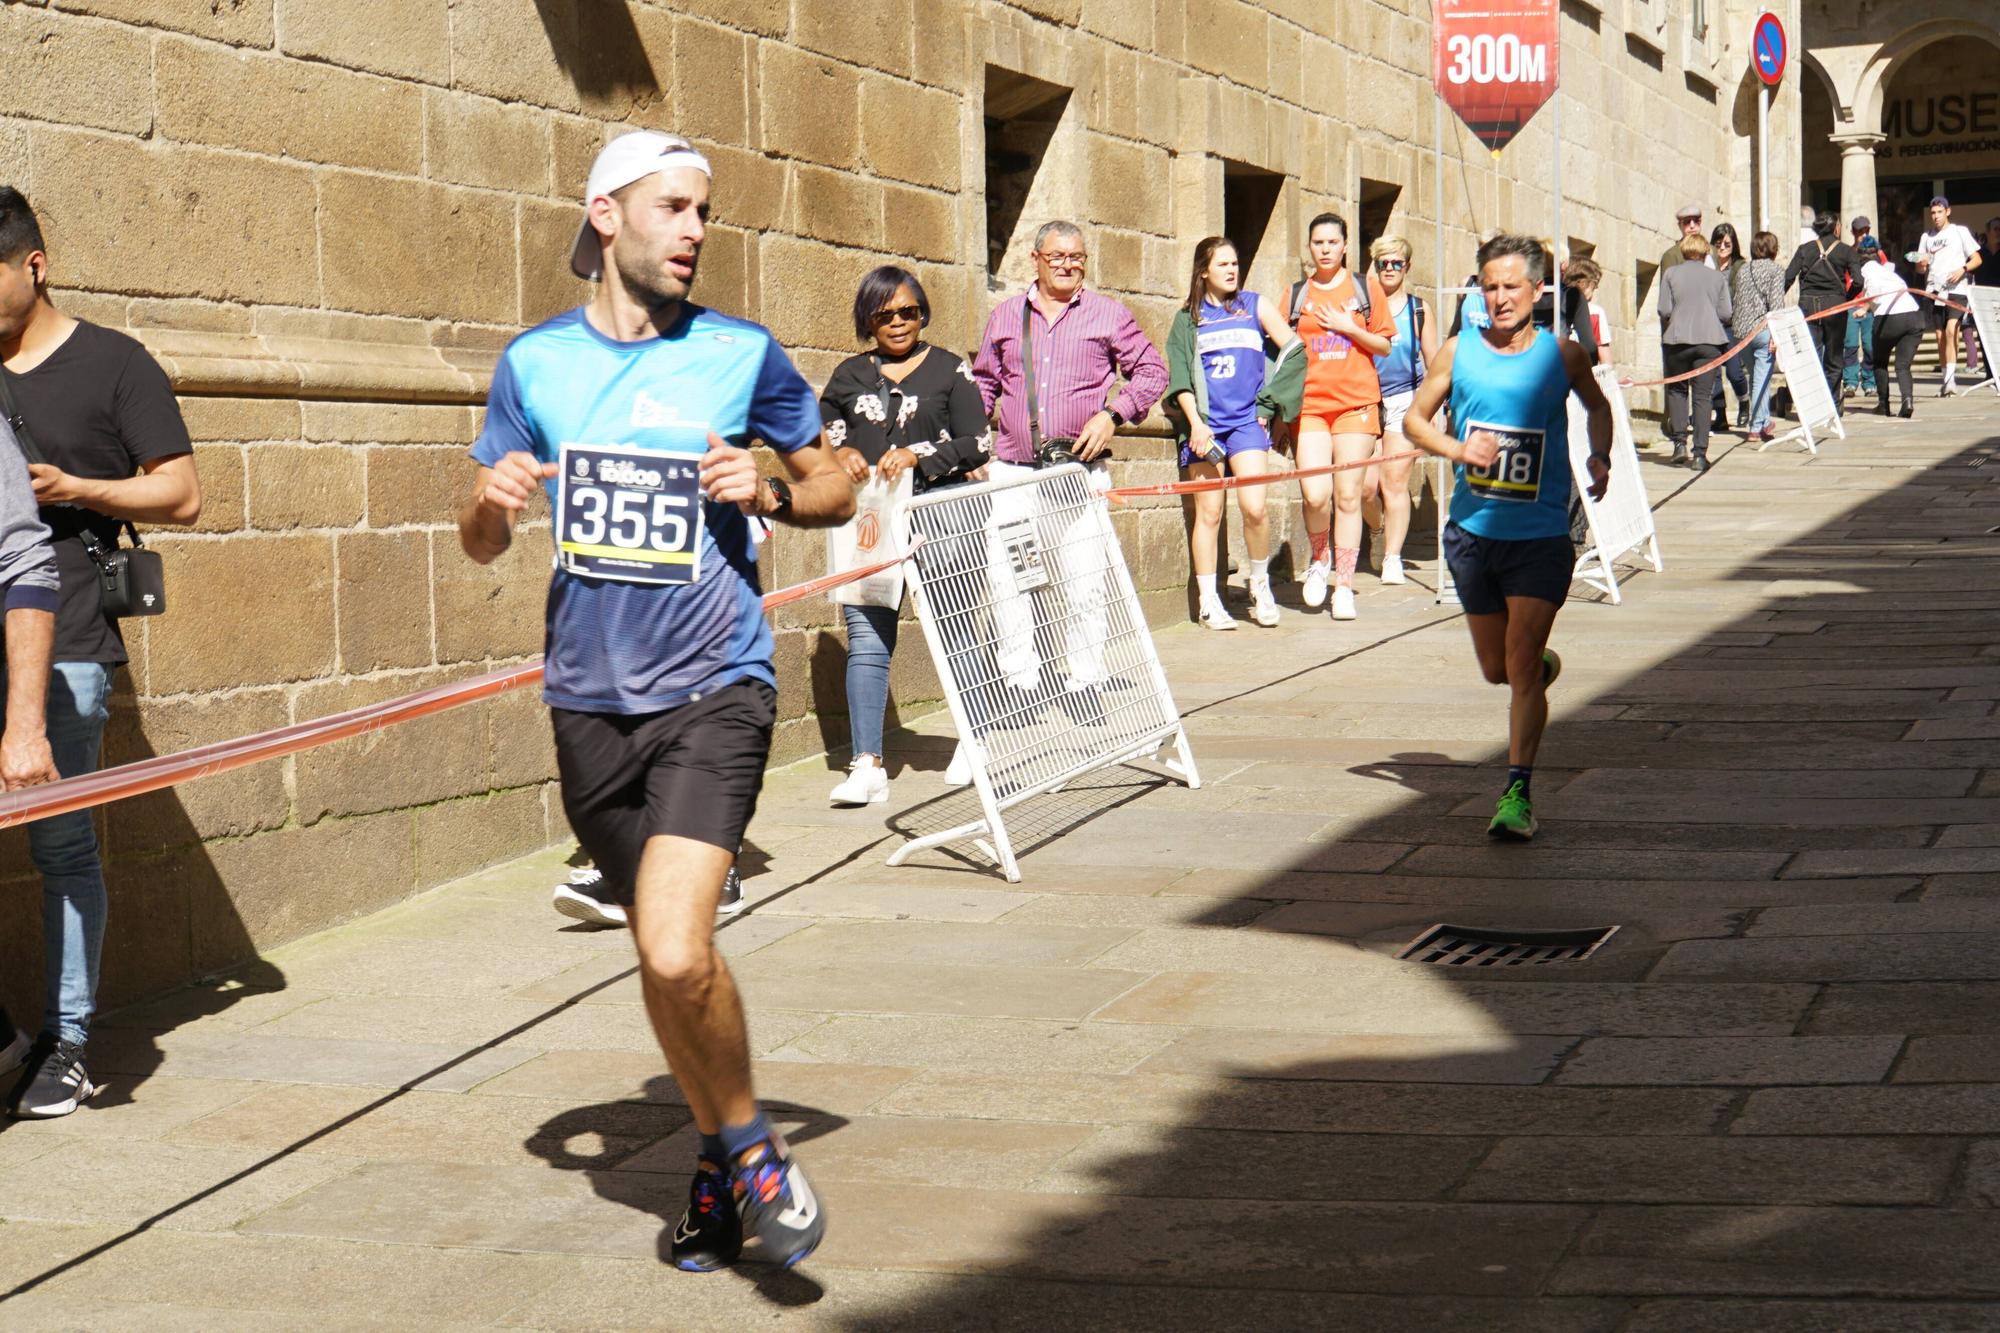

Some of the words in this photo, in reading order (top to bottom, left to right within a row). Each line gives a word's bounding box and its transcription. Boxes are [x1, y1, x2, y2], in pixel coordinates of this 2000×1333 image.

[1447, 33, 1546, 84] 300M
[1210, 354, 1236, 379] 23
[569, 486, 689, 553] 355
